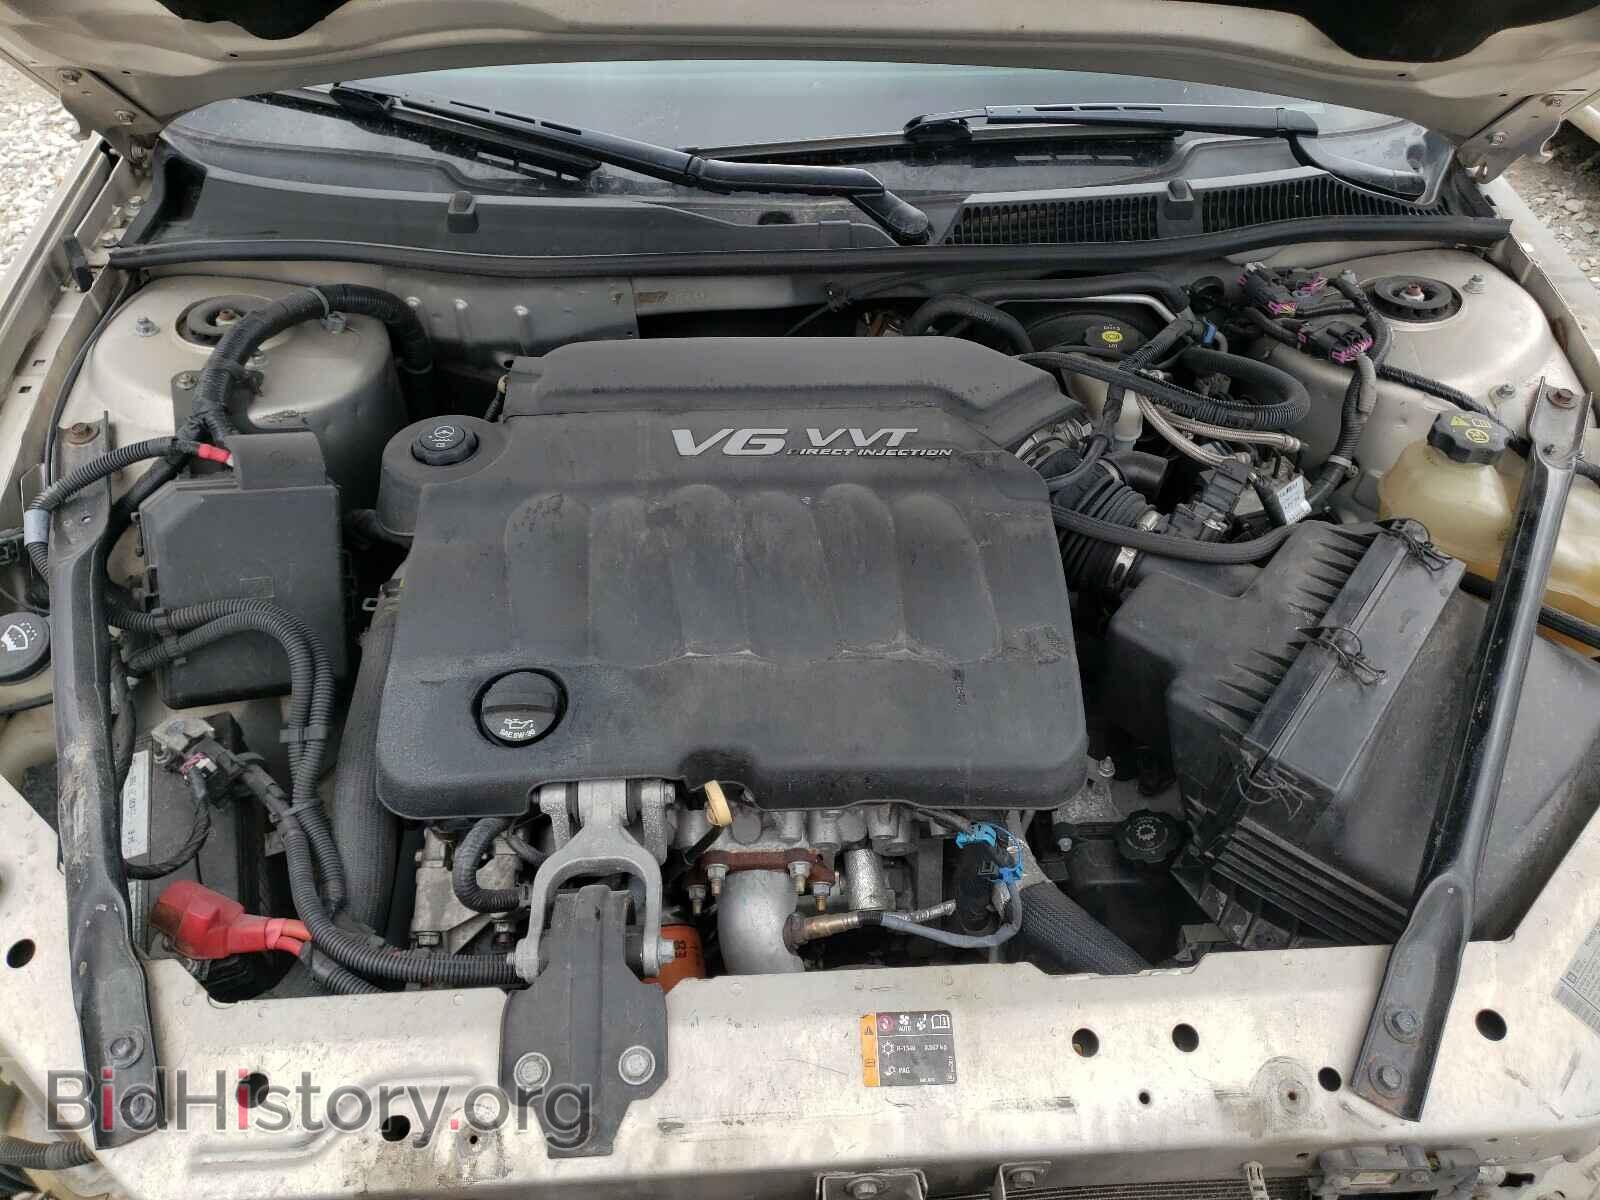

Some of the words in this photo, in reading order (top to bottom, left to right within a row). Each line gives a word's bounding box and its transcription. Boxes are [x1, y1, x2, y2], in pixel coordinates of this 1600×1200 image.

[672, 428, 788, 456] V6
[806, 428, 918, 446] VVT
[857, 448, 953, 456] INJECTION
